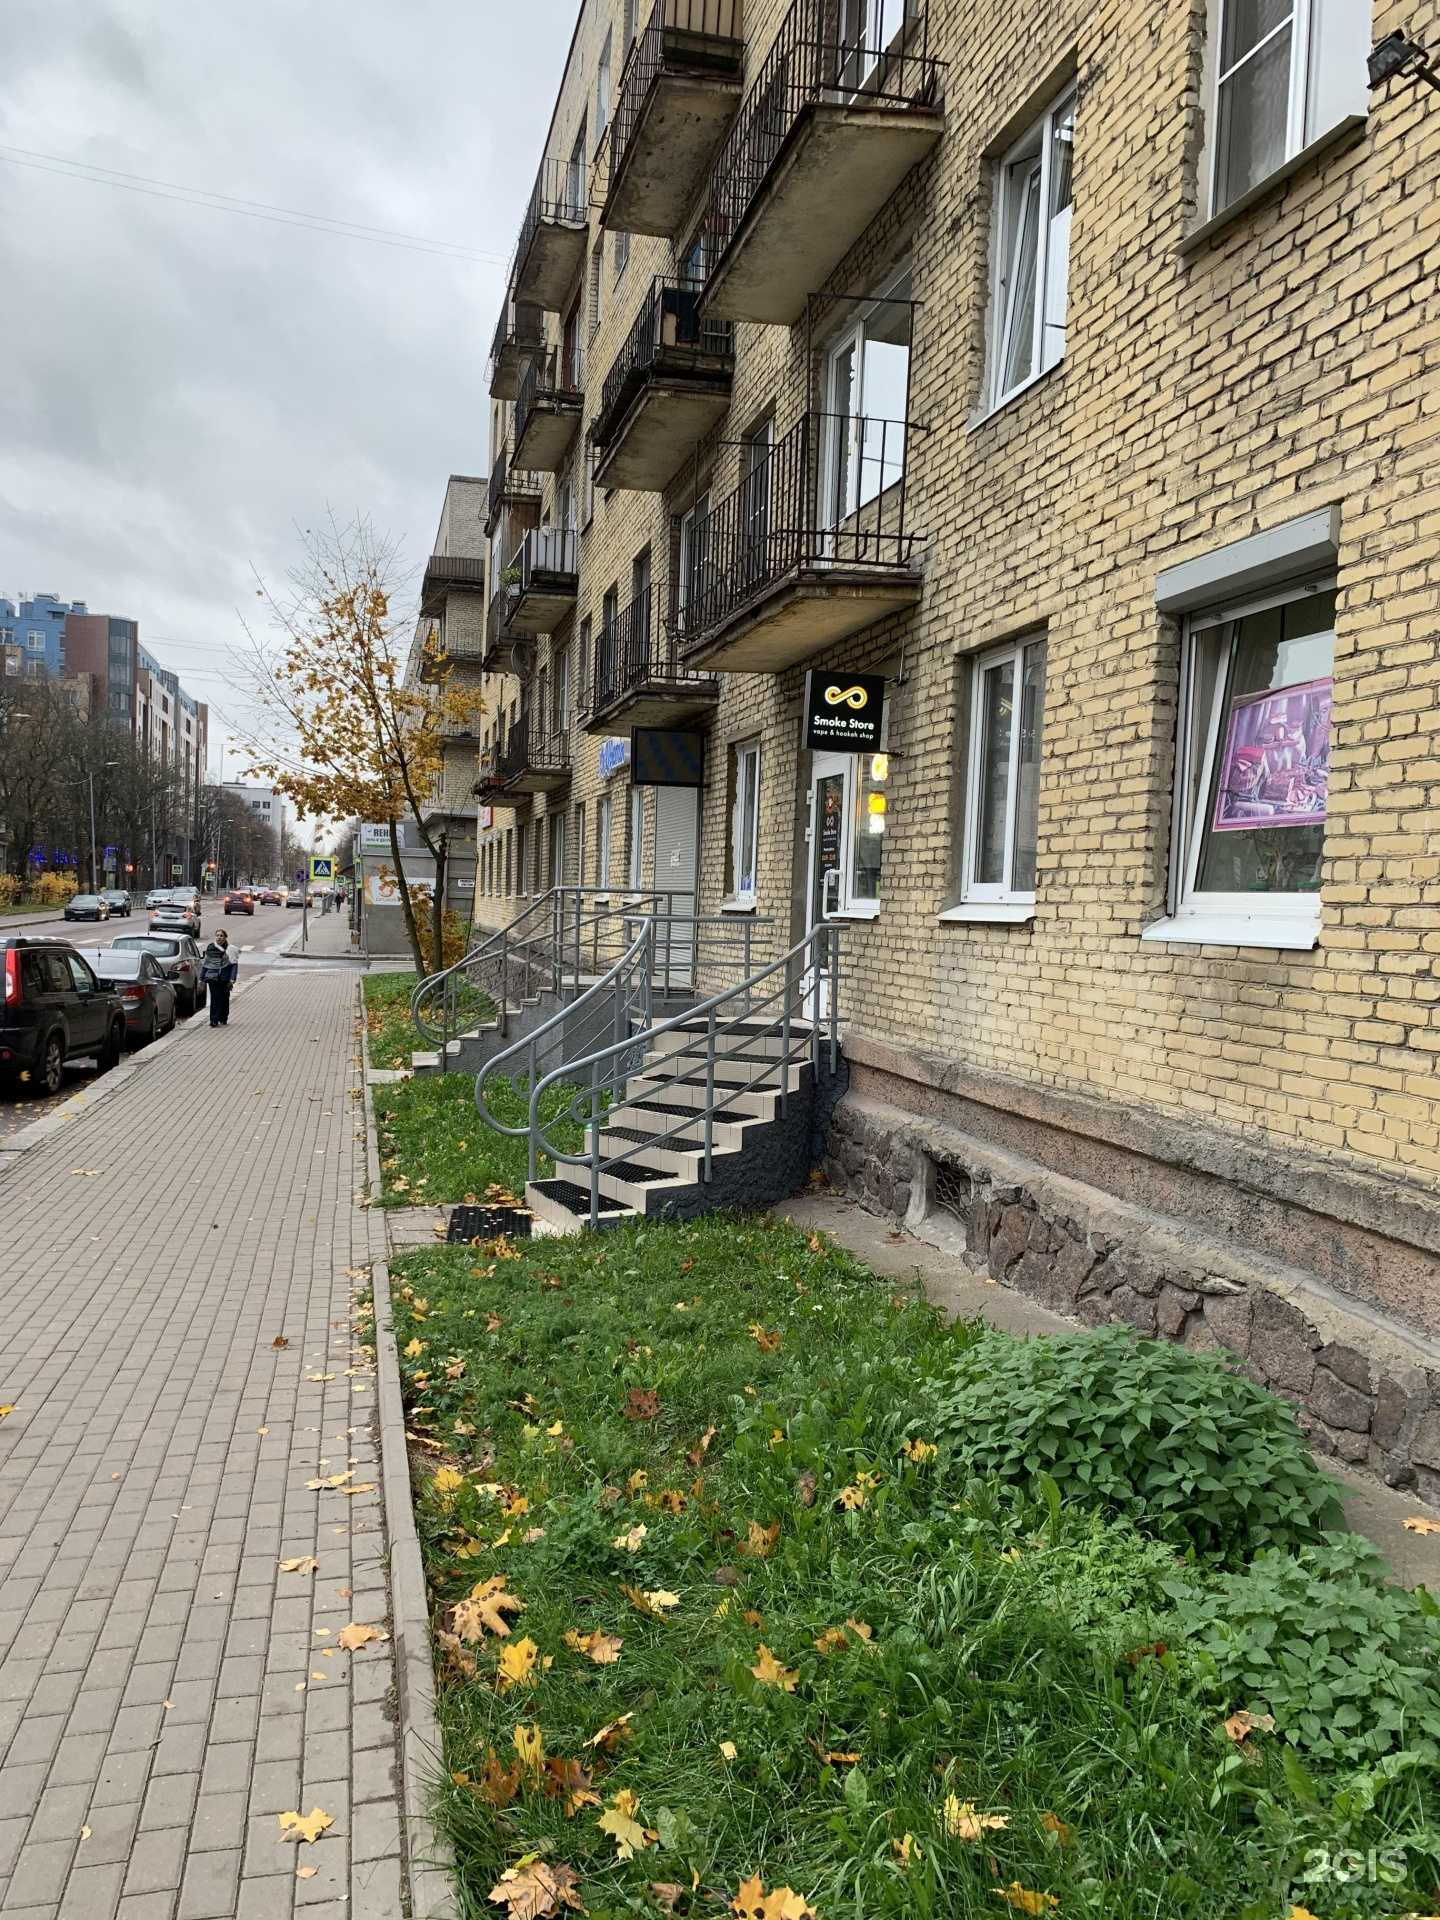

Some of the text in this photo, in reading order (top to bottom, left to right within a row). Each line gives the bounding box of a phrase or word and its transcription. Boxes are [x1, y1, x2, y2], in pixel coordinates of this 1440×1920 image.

[814, 715, 874, 730] Smoke Store
[836, 729, 858, 738] hookah
[859, 732, 874, 740] shop
[374, 828, 389, 837] REH
